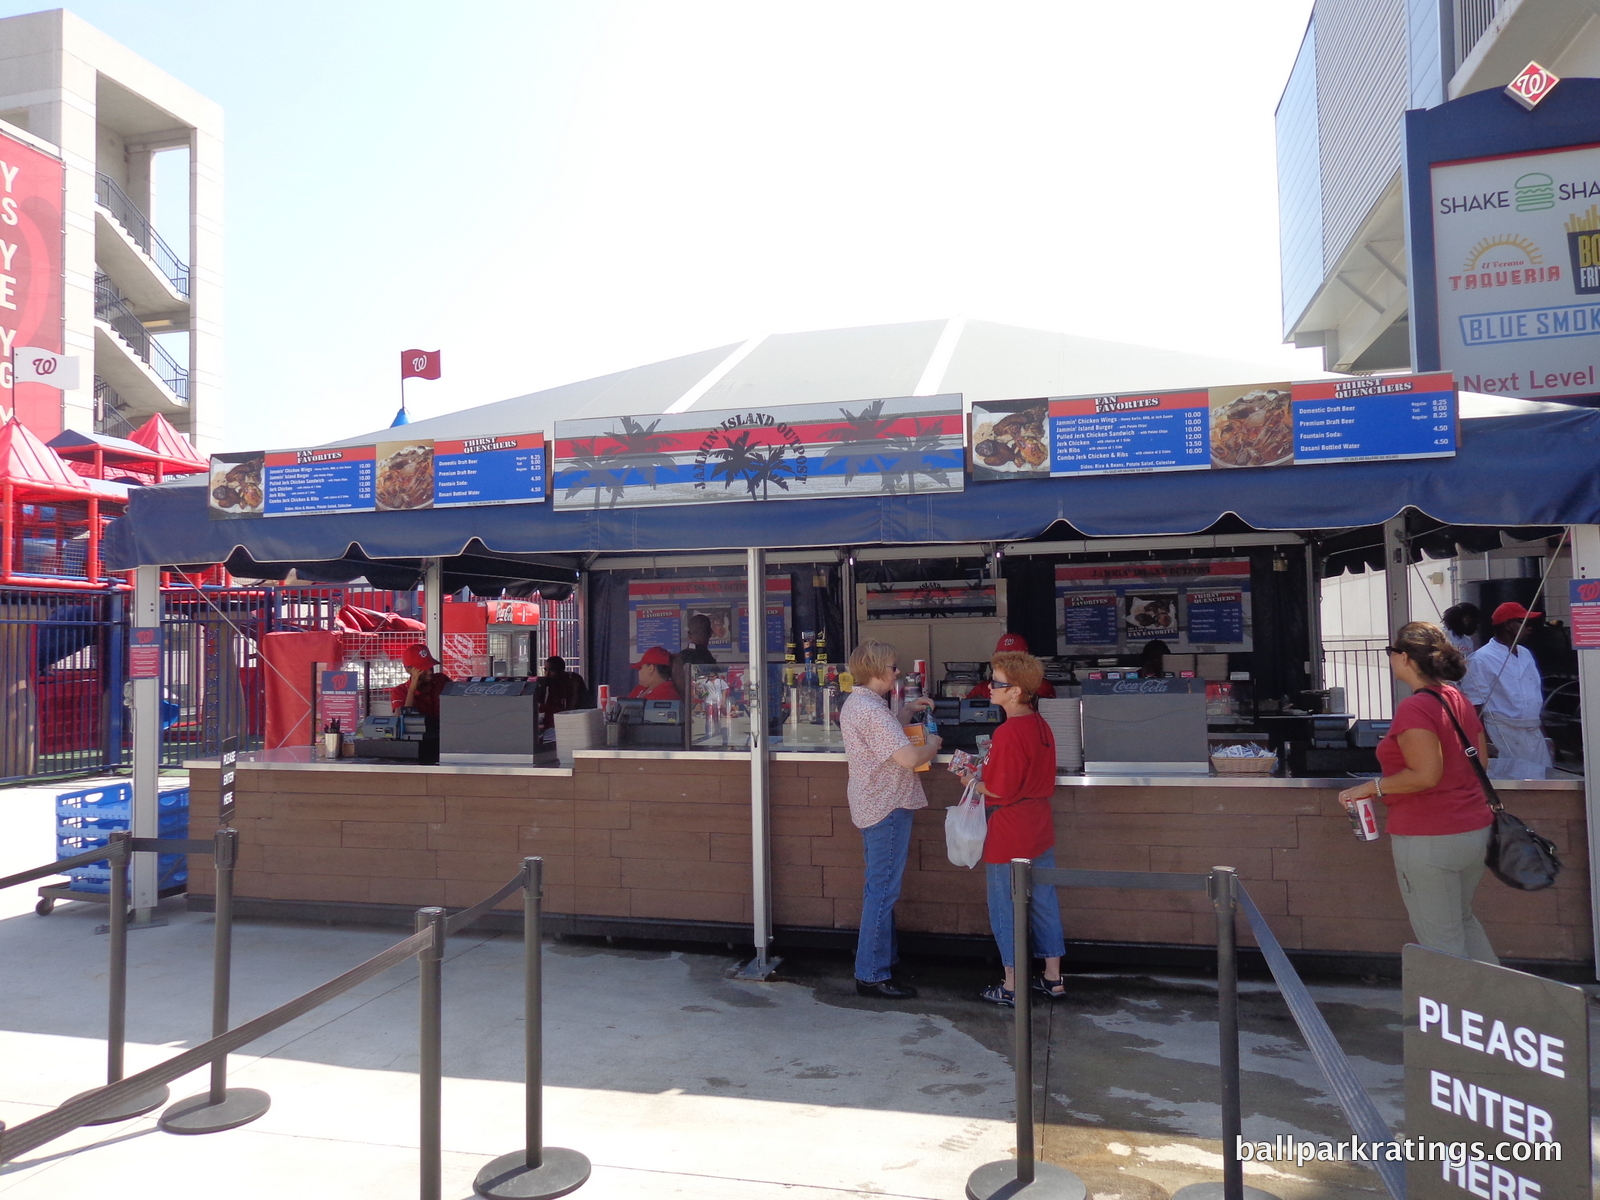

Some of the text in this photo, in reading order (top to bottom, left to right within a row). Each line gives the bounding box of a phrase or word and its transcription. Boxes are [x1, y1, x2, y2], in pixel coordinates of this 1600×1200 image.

[1517, 69, 1547, 98] W
[1440, 190, 1510, 214] SHAKE
[1481, 260, 1525, 270] El Verano
[1448, 265, 1562, 291] TAQUERIA
[1470, 315, 1528, 341] BLUE
[32, 357, 57, 376] W
[412, 354, 428, 373] W
[1334, 378, 1384, 390] THIRST
[1463, 365, 1595, 393] Next Level
[1335, 382, 1412, 399] QUENCHERS
[1094, 396, 1116, 405] FAN
[1094, 398, 1158, 413] FAVORITES
[464, 437, 496, 446] THIRST
[464, 440, 516, 454] QUENCHERS
[297, 452, 342, 464] FAVORITES
[693, 412, 808, 490] JAMMIN' ISLAND OUTPOST
[1193, 596, 1236, 604] QUENCHERS
[136, 629, 155, 644] W
[331, 672, 348, 691] W
[465, 683, 511, 695] Coca-Cola
[1112, 679, 1170, 693] Coca-Cola
[1419, 996, 1566, 1079] PLEASE
[1430, 1070, 1554, 1150] ENTER
